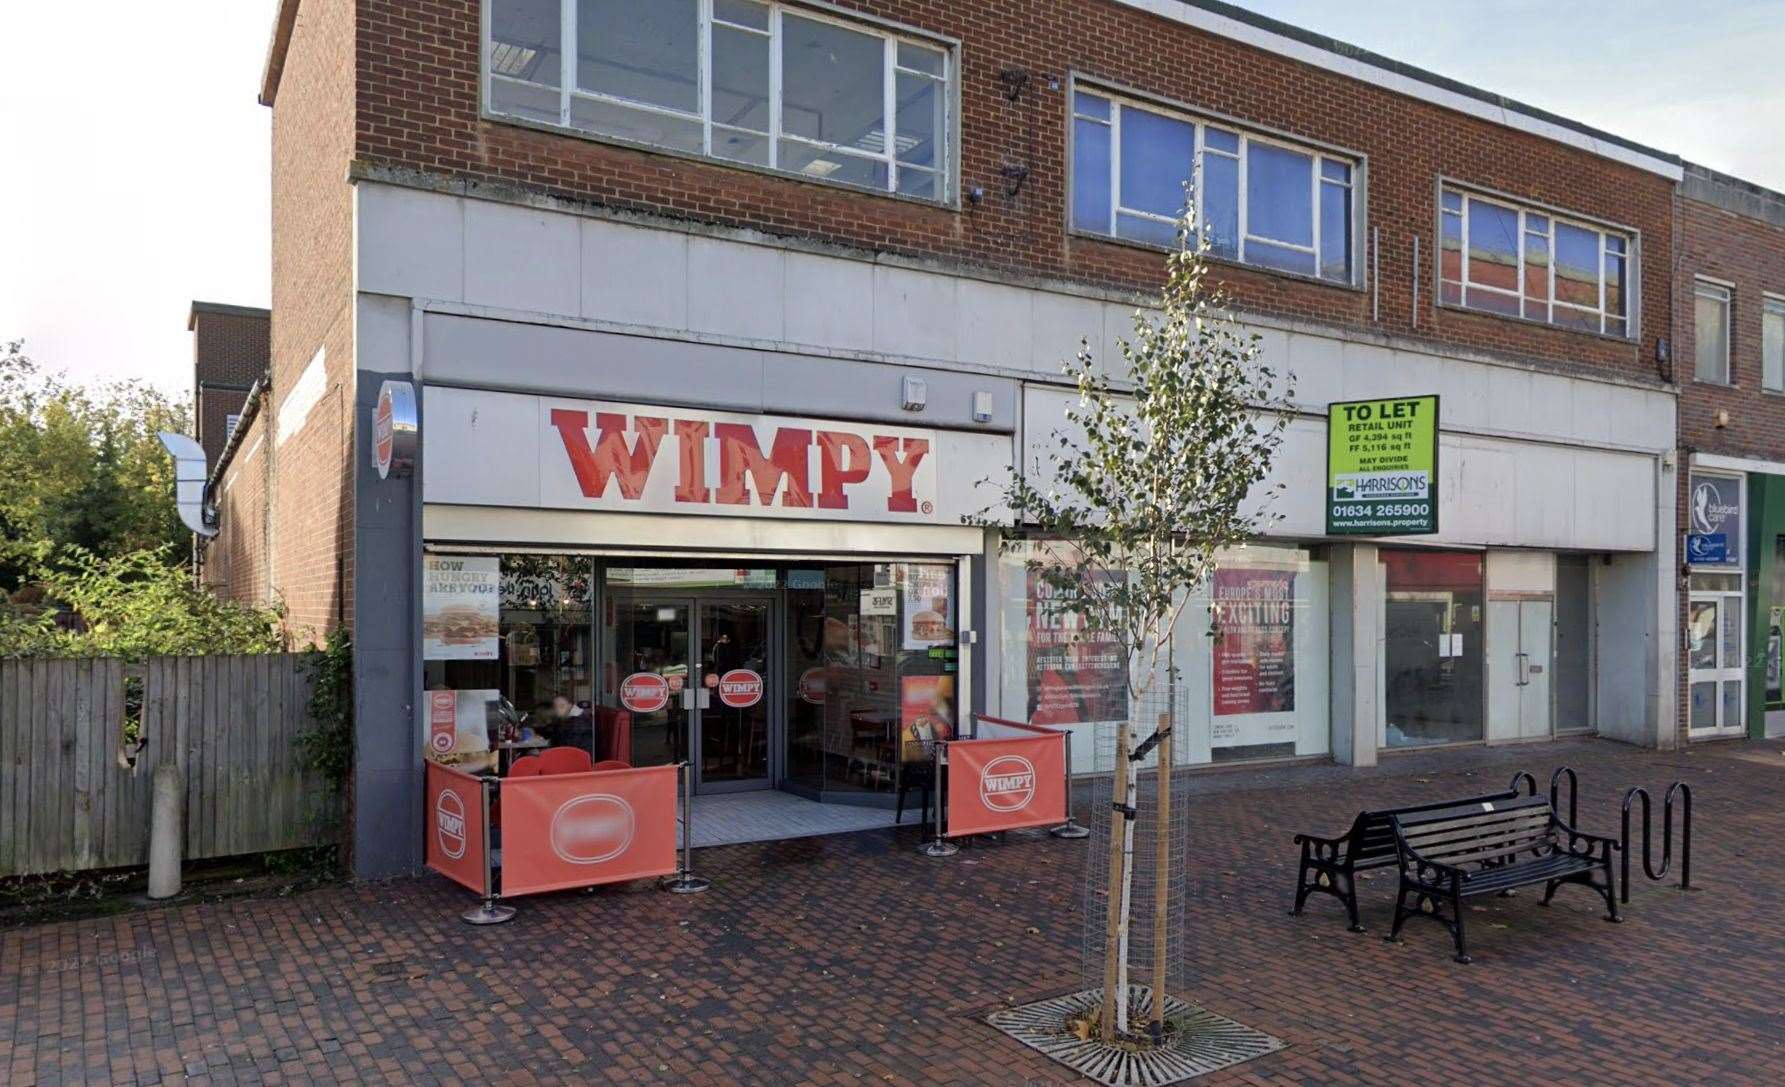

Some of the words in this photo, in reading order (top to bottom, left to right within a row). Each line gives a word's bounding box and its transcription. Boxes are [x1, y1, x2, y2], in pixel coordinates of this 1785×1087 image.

[1343, 405, 1371, 422] TO
[1380, 401, 1420, 419] LET
[1348, 422, 1384, 432] RETAIL
[1387, 420, 1414, 430] UNIT
[1349, 434, 1361, 443] GF
[551, 408, 929, 513] WIMPY
[1379, 455, 1408, 463] DIVIDE
[1355, 476, 1425, 492] HARRISONS
[1333, 505, 1372, 517] 01634
[1376, 503, 1429, 516] 265900
[1333, 517, 1428, 529] www.harrisons.property
[429, 560, 464, 571] HOW
[1217, 601, 1290, 624] EXCITING
[722, 683, 761, 694] WIMPY
[985, 775, 1032, 792] WIMPY
